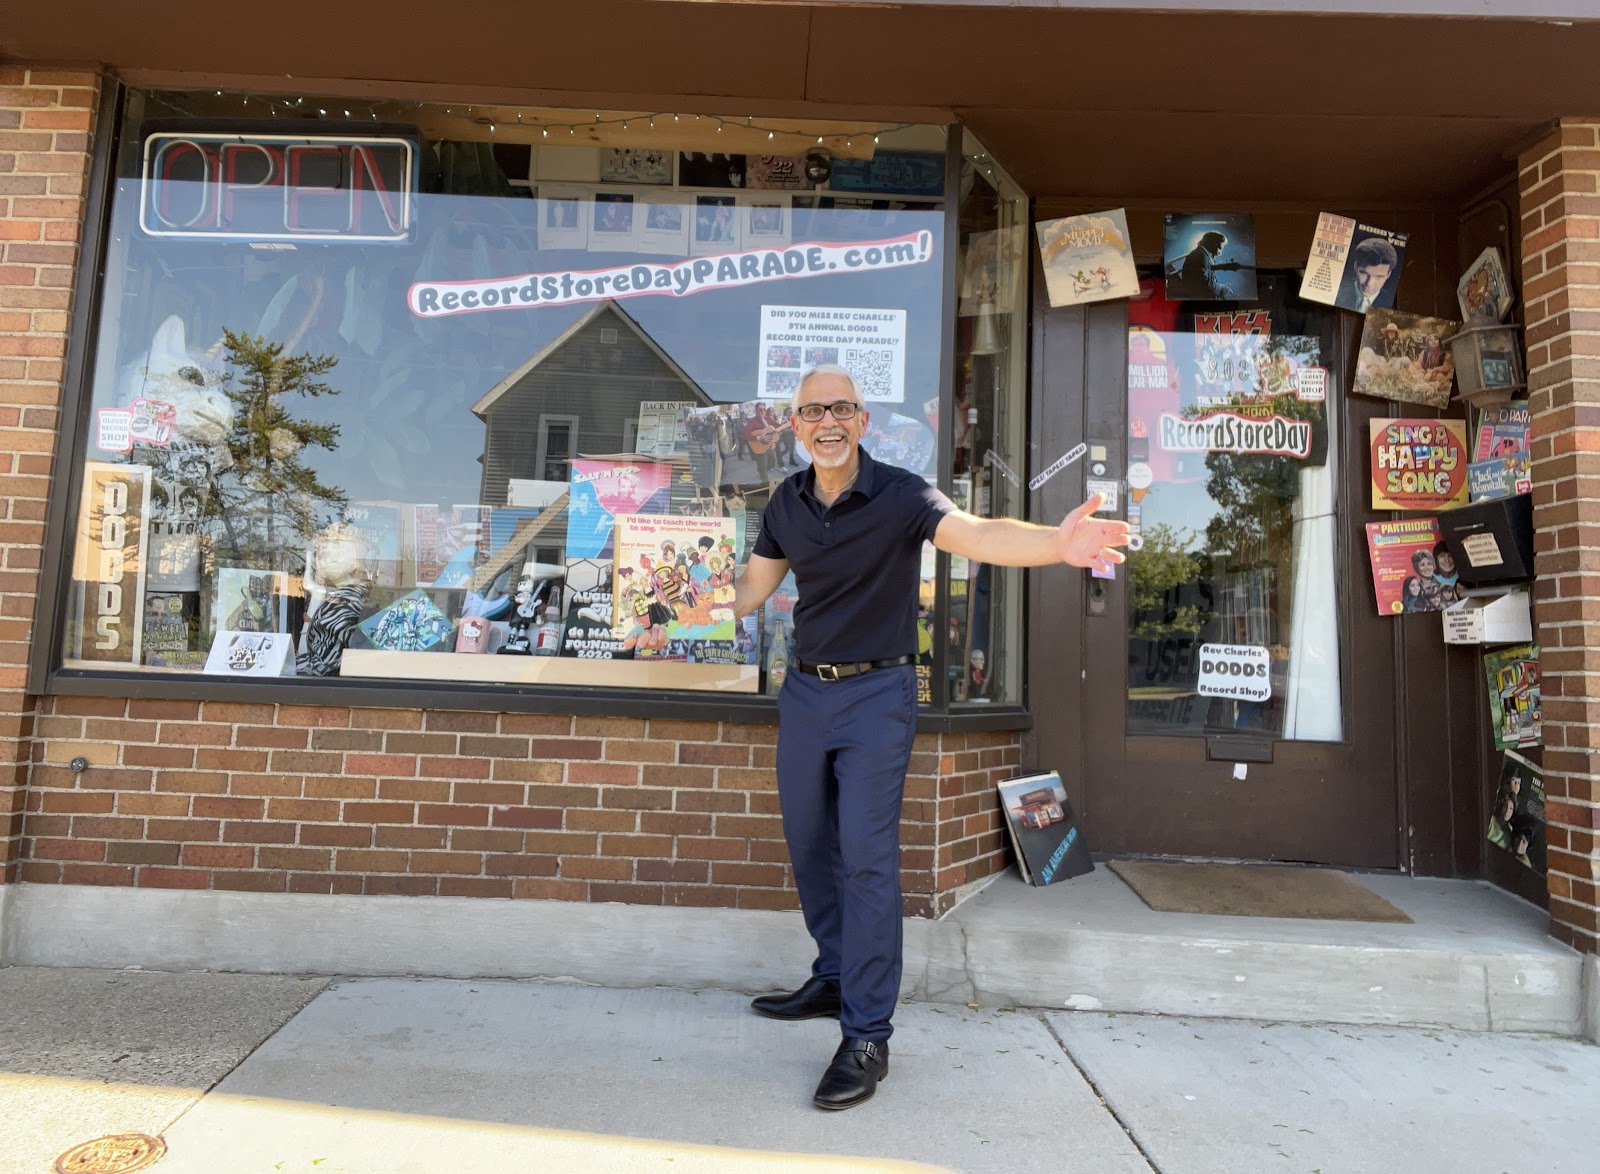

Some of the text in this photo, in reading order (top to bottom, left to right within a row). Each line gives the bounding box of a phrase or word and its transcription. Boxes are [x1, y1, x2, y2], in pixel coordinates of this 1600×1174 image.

[773, 161, 793, 174] 22
[153, 139, 407, 234] OPEN
[1061, 227, 1105, 246] MUPPET
[1359, 223, 1395, 238] BOBBY
[1387, 238, 1406, 248] VEE
[770, 310, 787, 318] DID
[788, 310, 807, 318] YOU
[832, 312, 851, 320] REV
[852, 313, 897, 322] CHARLES'
[808, 324, 846, 332] ANNUAL
[1195, 312, 1272, 346] KISS
[766, 334, 803, 342] RECORD
[805, 335, 834, 343] STORE
[836, 336, 854, 344] DAY
[1129, 365, 1168, 377] MILLION
[643, 402, 665, 410] BACK
[101, 433, 127, 441] SHOP
[1163, 416, 1309, 454] RecordStoreDay
[1386, 425, 1449, 445] SING A
[1045, 458, 1065, 476] TAPES!
[1065, 444, 1085, 462] TAPES!
[1377, 444, 1458, 472] HAPPY
[613, 465, 642, 478] PEPA
[1475, 466, 1492, 483] Jack
[1386, 470, 1452, 495] SONG
[627, 516, 721, 528] I'd like to teach the world
[1381, 520, 1434, 534] PARTRIDGE
[95, 481, 129, 650] DODDS
[573, 591, 613, 604] AUGU
[568, 627, 584, 639] de
[588, 627, 612, 639] MA
[565, 639, 626, 652] FOUNDED
[1203, 646, 1265, 657] Rev Charles'
[578, 649, 613, 659] 2020
[695, 649, 704, 659] THE
[704, 648, 720, 658] SUPER
[1202, 660, 1267, 678] DODDS
[1200, 685, 1268, 699] Record Shop!
